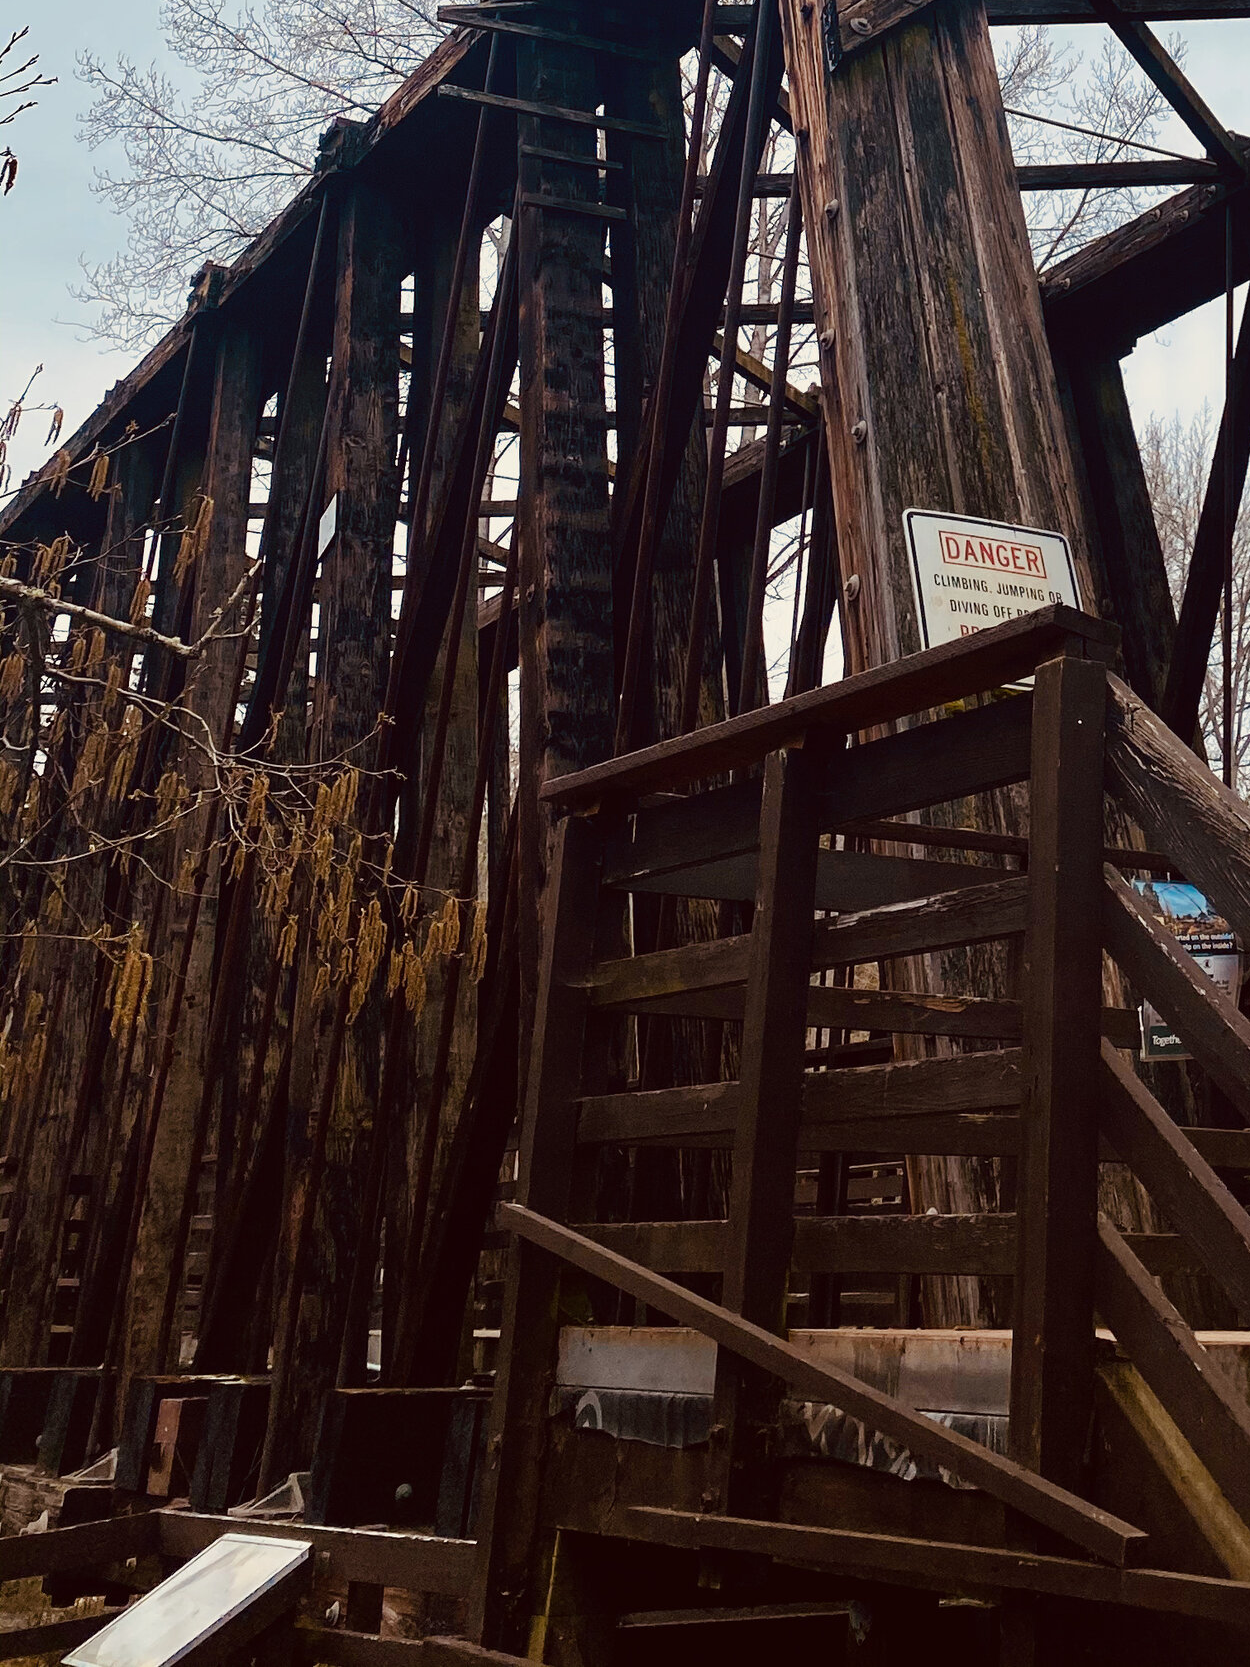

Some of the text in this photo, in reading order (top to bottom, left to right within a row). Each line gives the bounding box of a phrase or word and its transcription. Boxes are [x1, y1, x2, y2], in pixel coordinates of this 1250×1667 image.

[945, 536, 1040, 573] DANGER
[997, 583, 1045, 602] JUMPING
[1049, 591, 1063, 604] OR
[950, 599, 989, 617] DIVING
[993, 605, 1012, 620] OFF
